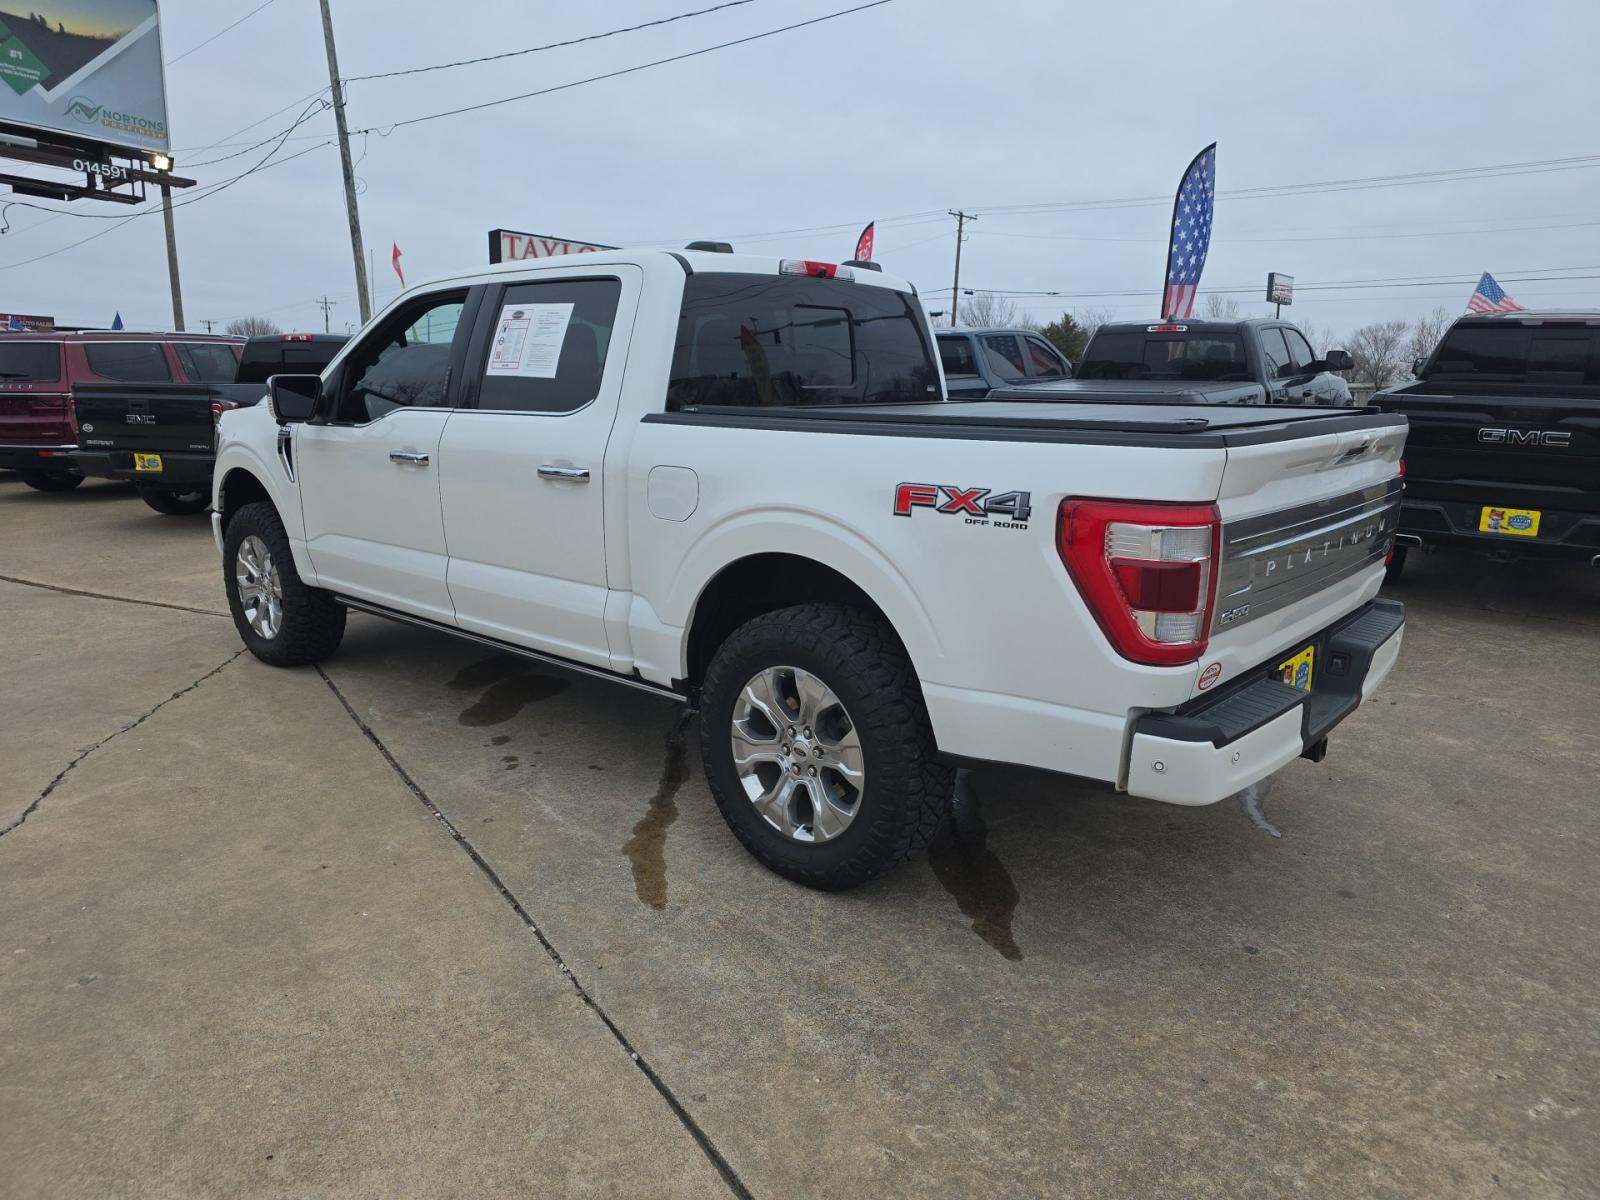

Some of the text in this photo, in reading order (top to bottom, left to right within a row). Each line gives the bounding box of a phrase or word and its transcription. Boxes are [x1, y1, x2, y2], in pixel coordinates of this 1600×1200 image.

[102, 109, 164, 131] NORTONS
[73, 159, 128, 179] 014591
[503, 234, 597, 259] TAY
[1477, 427, 1572, 447] GMC
[893, 482, 1032, 522] FX4
[964, 517, 1029, 530] OFF ROAD
[1265, 518, 1386, 577] PLATINUM
